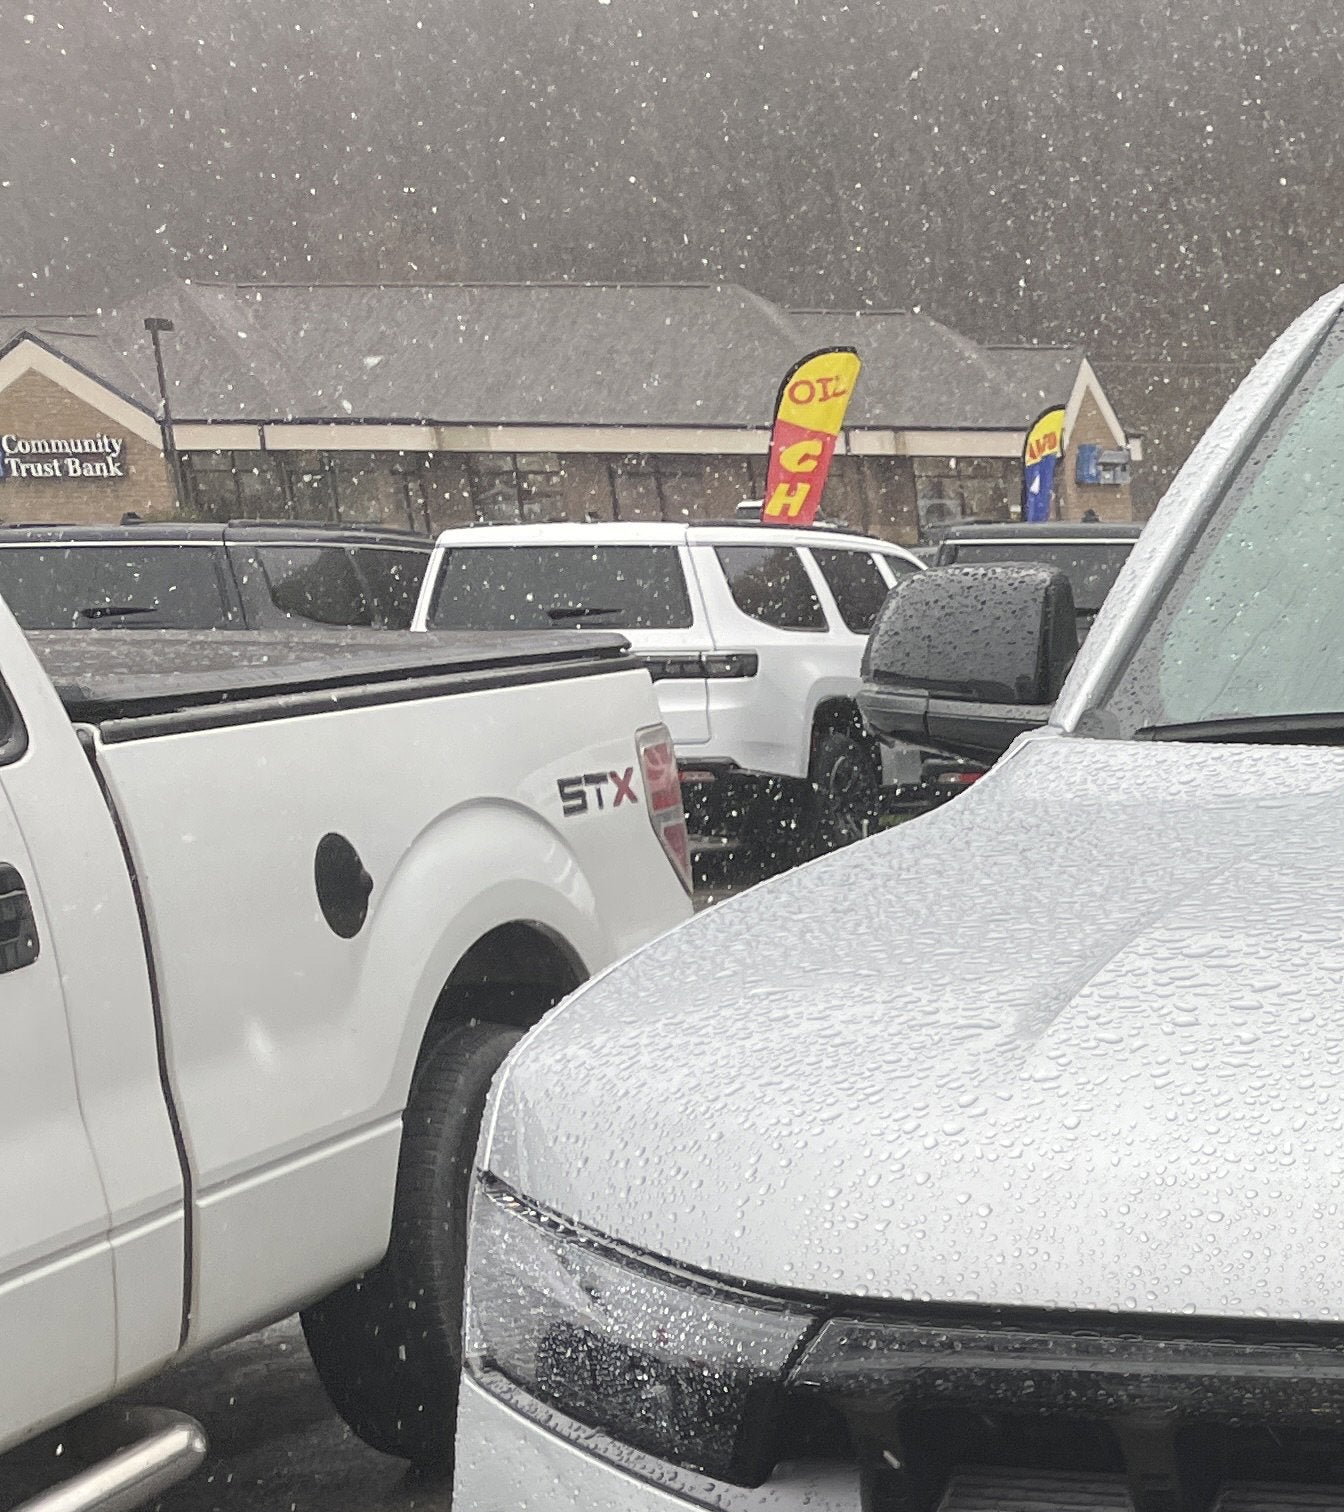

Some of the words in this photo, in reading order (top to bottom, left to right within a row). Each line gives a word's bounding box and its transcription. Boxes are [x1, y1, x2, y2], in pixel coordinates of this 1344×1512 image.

[788, 374, 847, 405] OIL
[2, 432, 122, 457] Community
[4, 457, 62, 477] Trust
[64, 456, 123, 478] Bank
[557, 766, 639, 818] STX
